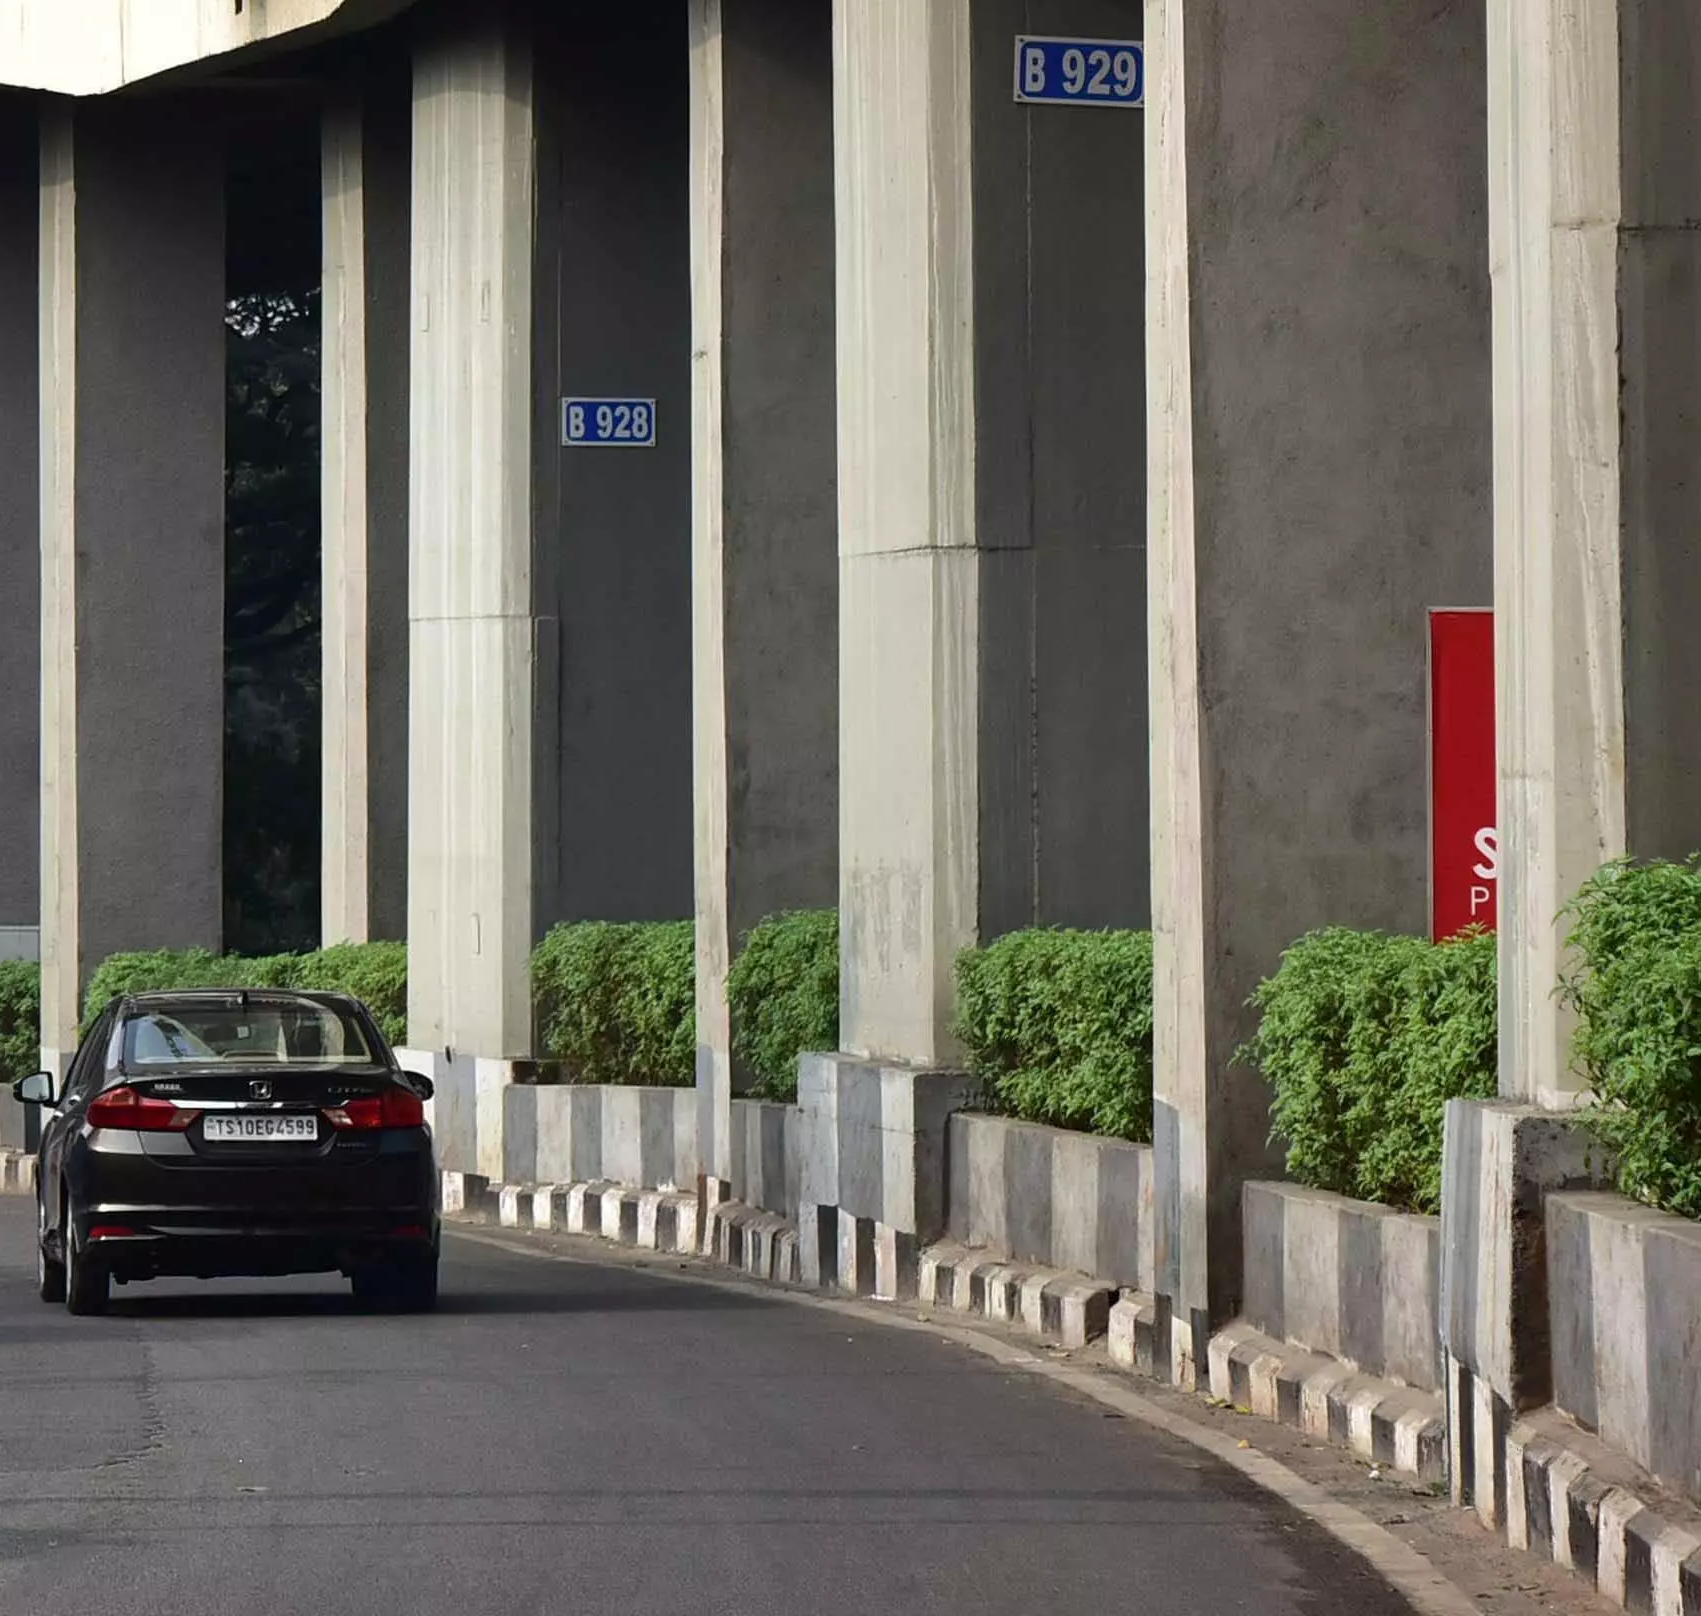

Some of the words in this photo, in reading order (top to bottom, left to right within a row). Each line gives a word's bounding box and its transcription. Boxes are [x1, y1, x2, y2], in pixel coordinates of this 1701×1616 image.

[1025, 47, 1046, 93] B
[1062, 49, 1138, 96] 929
[569, 405, 585, 439] B
[596, 404, 649, 440] 928
[216, 1119, 315, 1136] TS10EG4599
